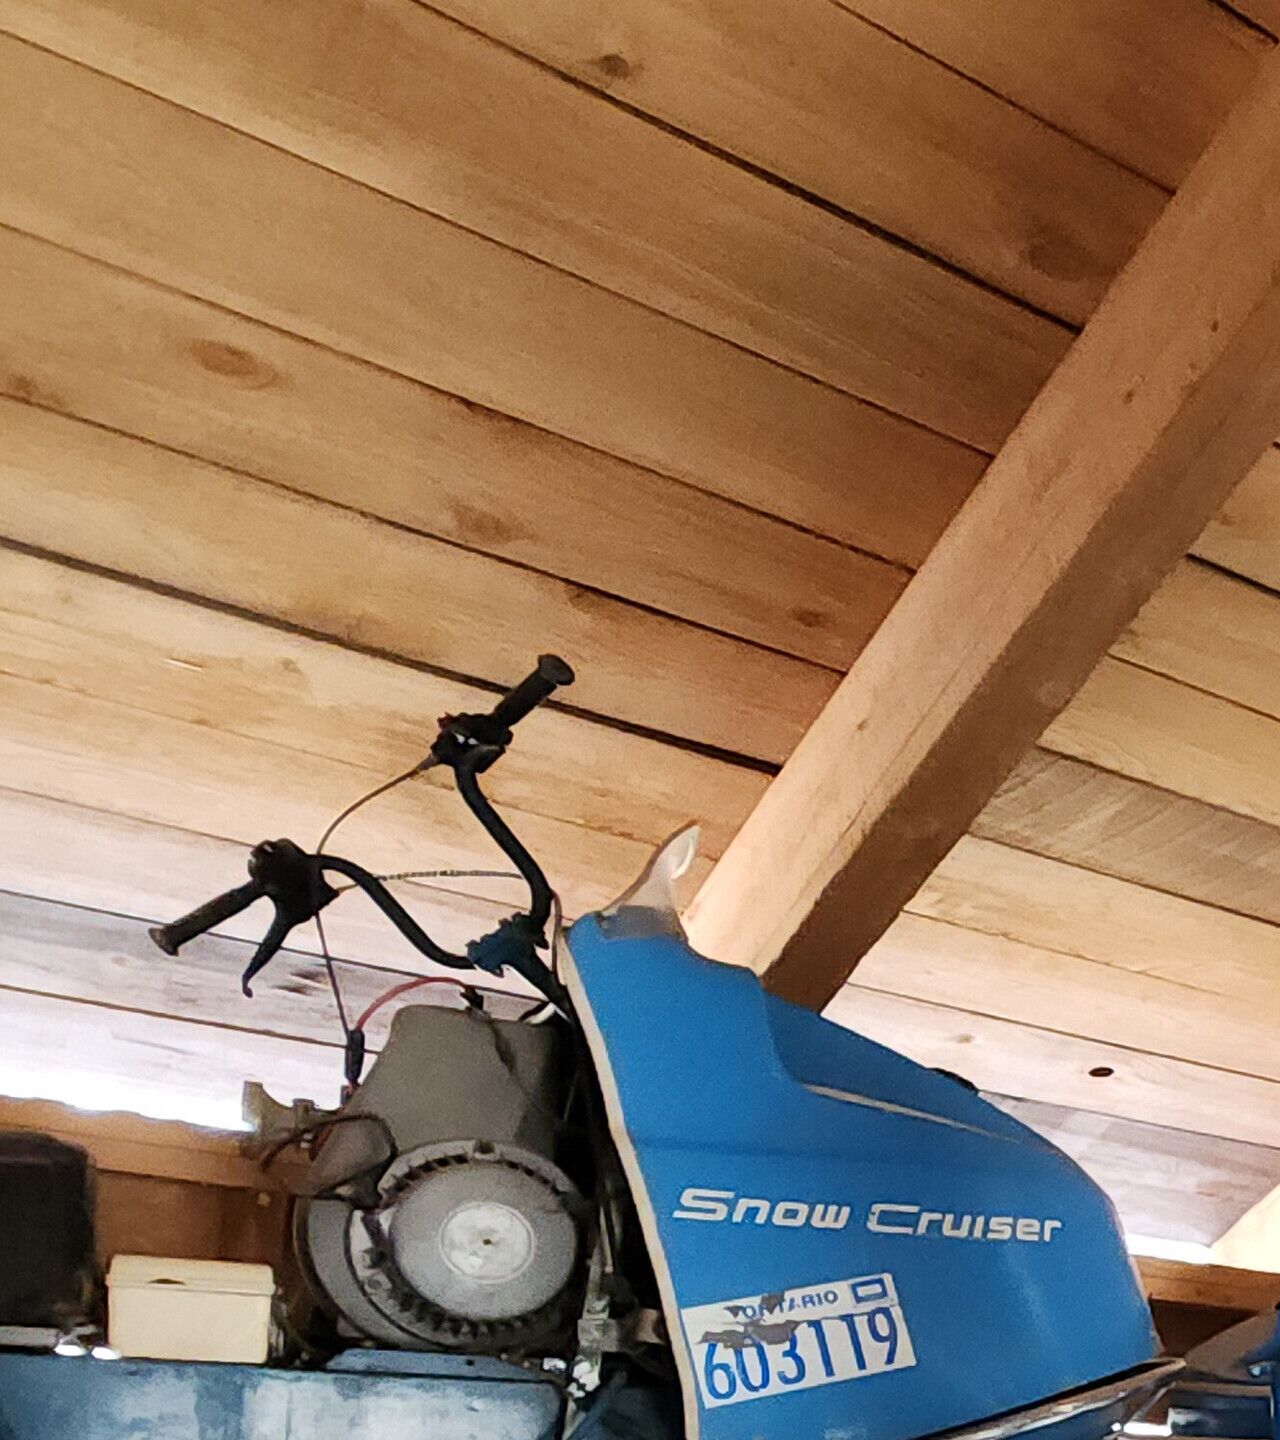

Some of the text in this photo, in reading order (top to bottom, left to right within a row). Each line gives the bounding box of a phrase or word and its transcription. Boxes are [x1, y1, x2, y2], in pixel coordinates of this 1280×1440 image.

[672, 1187, 1062, 1243] Snow Cruiser
[703, 1306, 898, 1400] 603119
